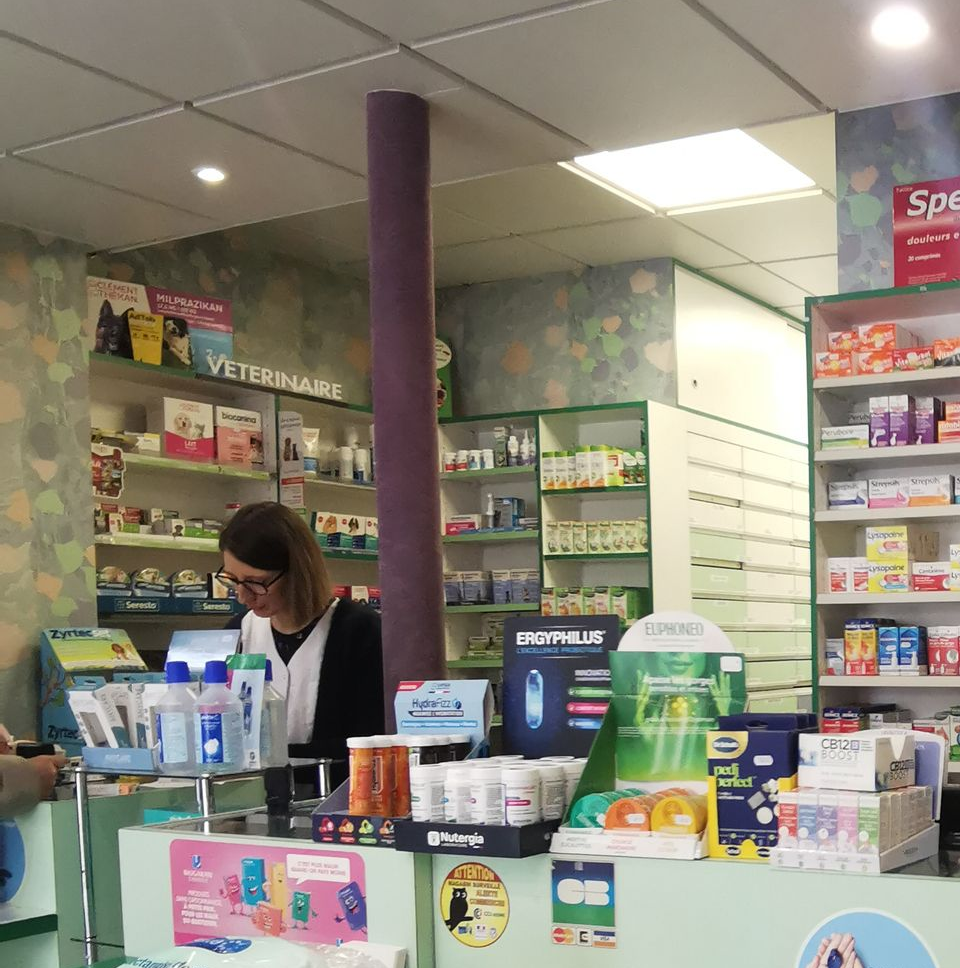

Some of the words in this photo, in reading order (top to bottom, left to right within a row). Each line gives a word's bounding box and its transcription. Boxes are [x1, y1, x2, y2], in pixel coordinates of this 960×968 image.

[907, 233, 950, 246] douleurs
[156, 293, 223, 313] MILPRAZIKAN
[208, 357, 343, 401] VETERINAIRE
[221, 411, 257, 424] biocanina
[910, 476, 941, 487] Strepsils
[126, 600, 157, 610] Seresto
[203, 602, 231, 611] Seresto
[821, 738, 851, 750] CB12
[821, 750, 859, 761] BOOST
[714, 763, 740, 777] pedi
[716, 775, 753, 789] perfect
[440, 831, 485, 846] Nutergia
[454, 865, 496, 880] ATTENTION
[557, 878, 610, 906] CB
